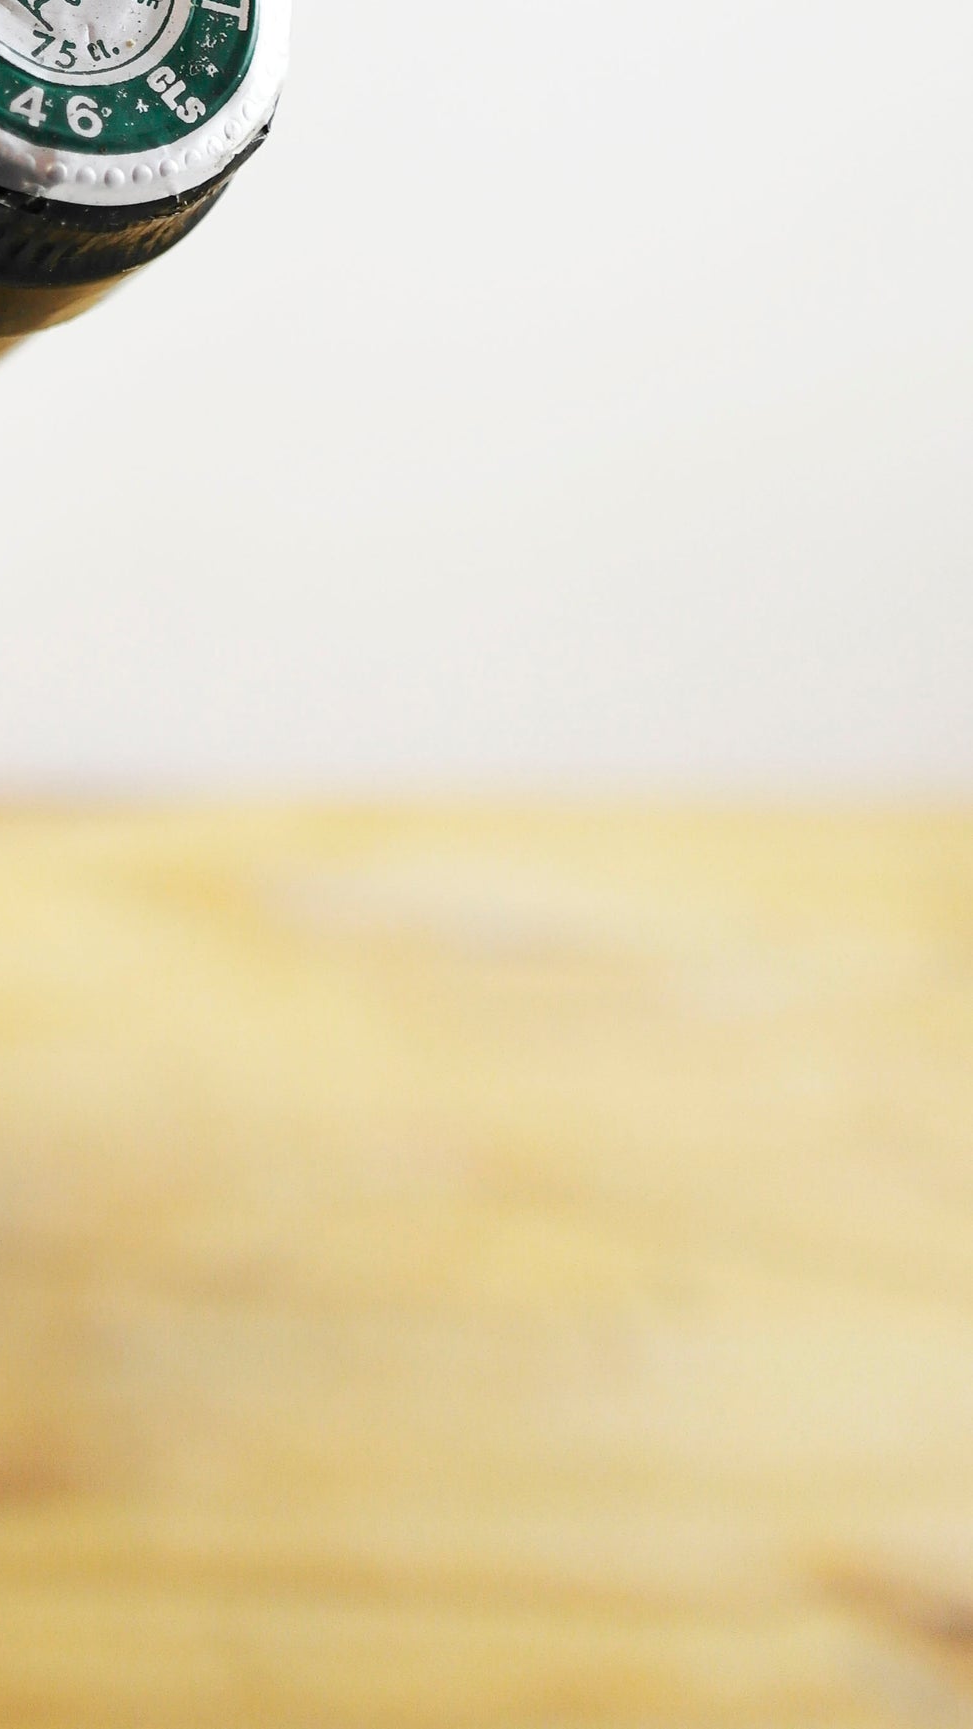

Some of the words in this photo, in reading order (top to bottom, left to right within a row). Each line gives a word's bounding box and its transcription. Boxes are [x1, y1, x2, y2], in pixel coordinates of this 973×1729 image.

[30, 29, 77, 69] 75
[9, 85, 104, 139] 46
[146, 66, 207, 124] CLS
